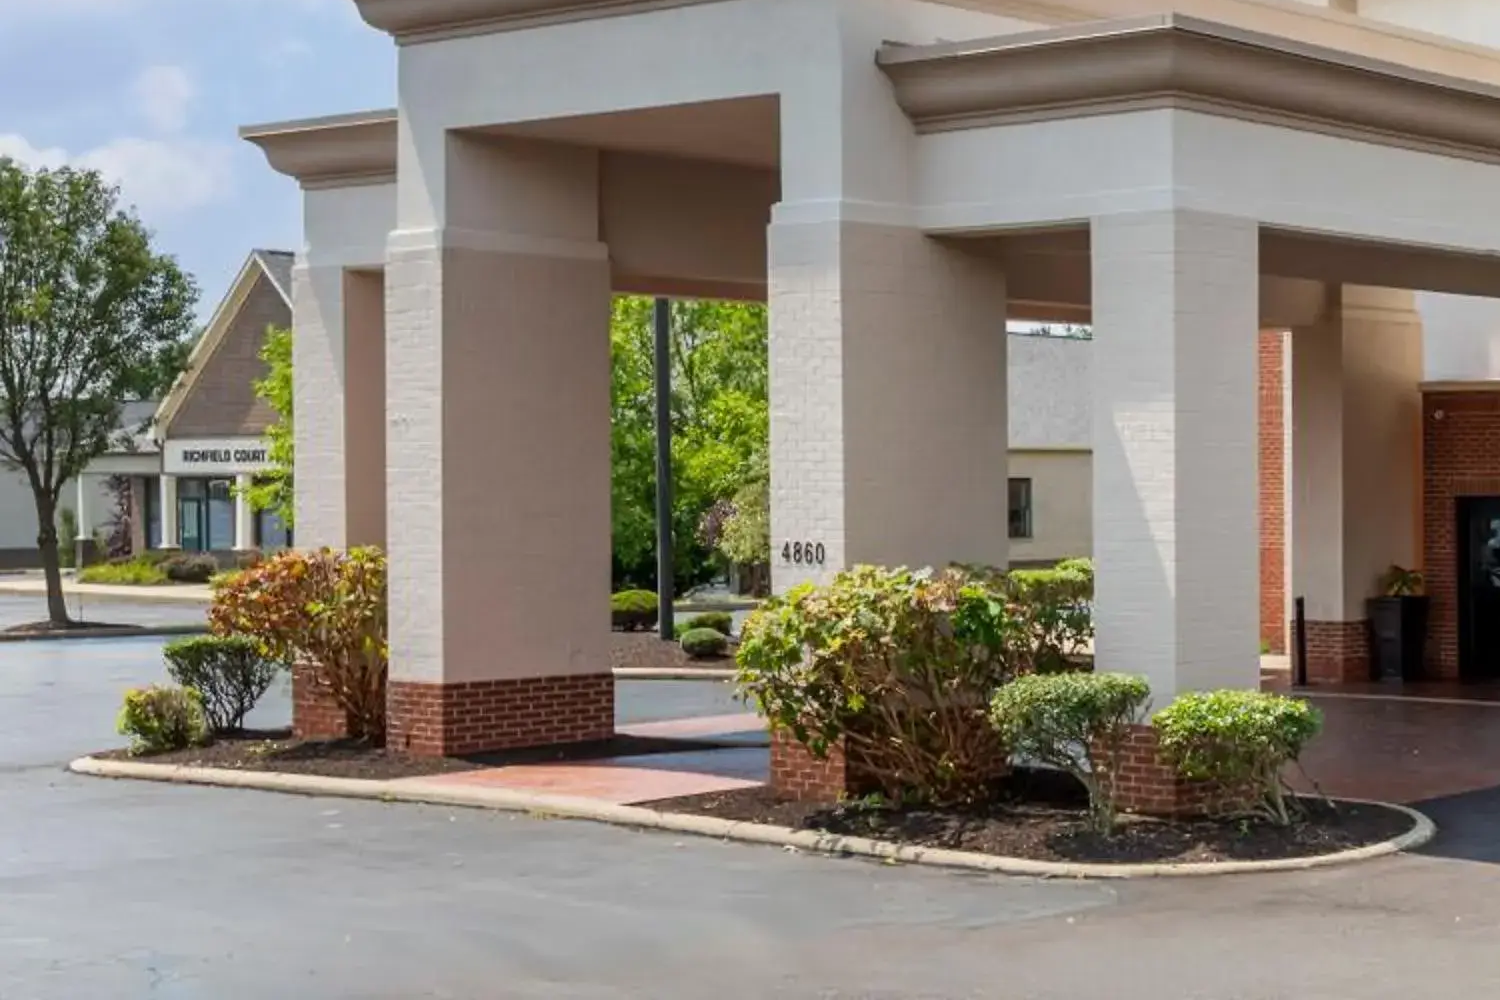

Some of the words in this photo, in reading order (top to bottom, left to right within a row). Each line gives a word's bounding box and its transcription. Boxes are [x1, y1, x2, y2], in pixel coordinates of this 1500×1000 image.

[183, 449, 231, 463] RICHFIELD
[233, 449, 268, 463] COURT
[781, 540, 825, 565] 4860
